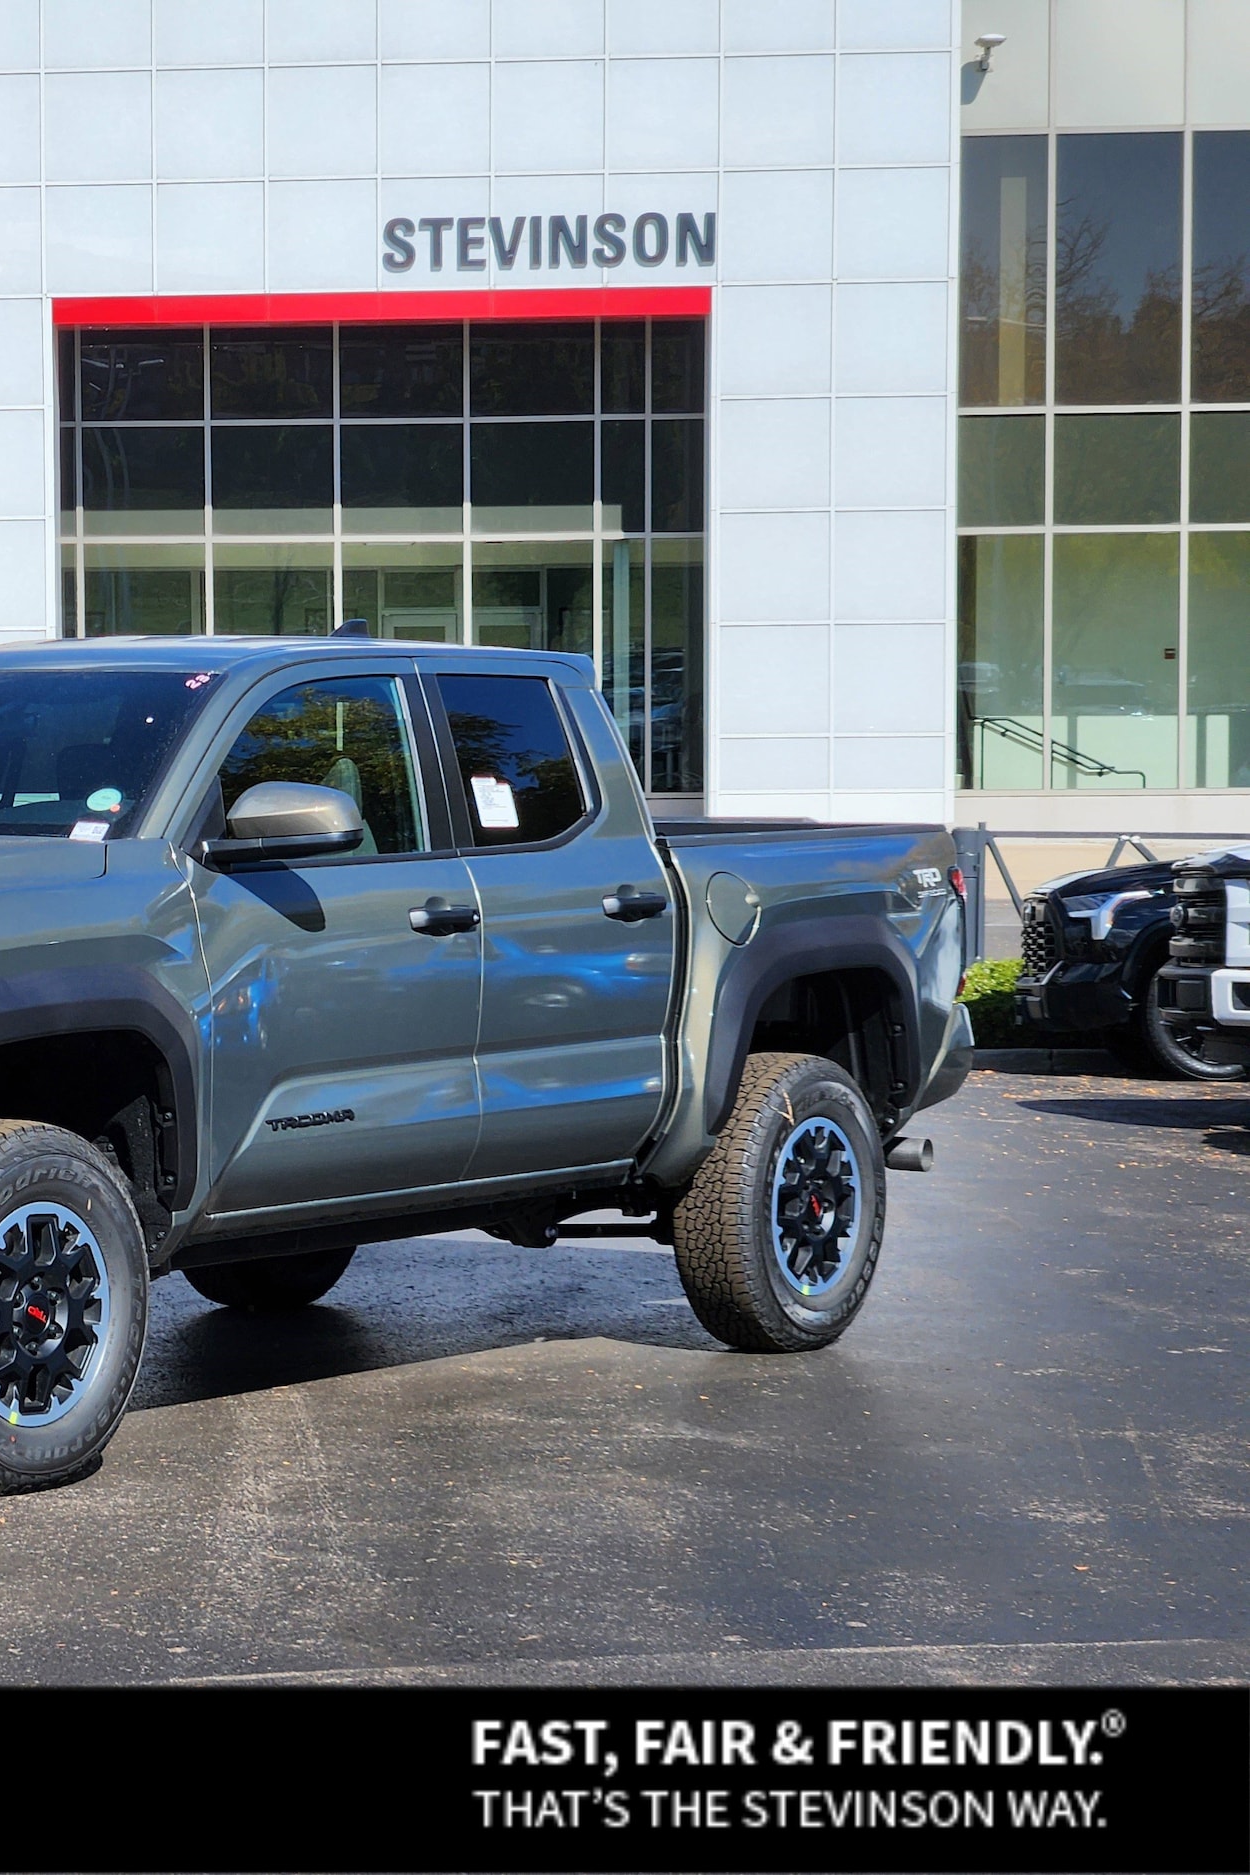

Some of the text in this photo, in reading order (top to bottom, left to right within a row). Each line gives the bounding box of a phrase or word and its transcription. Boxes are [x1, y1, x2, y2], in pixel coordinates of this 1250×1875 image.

[382, 211, 717, 273] STEVINSON
[912, 867, 942, 888] TRD
[265, 1108, 355, 1132] TACOMA
